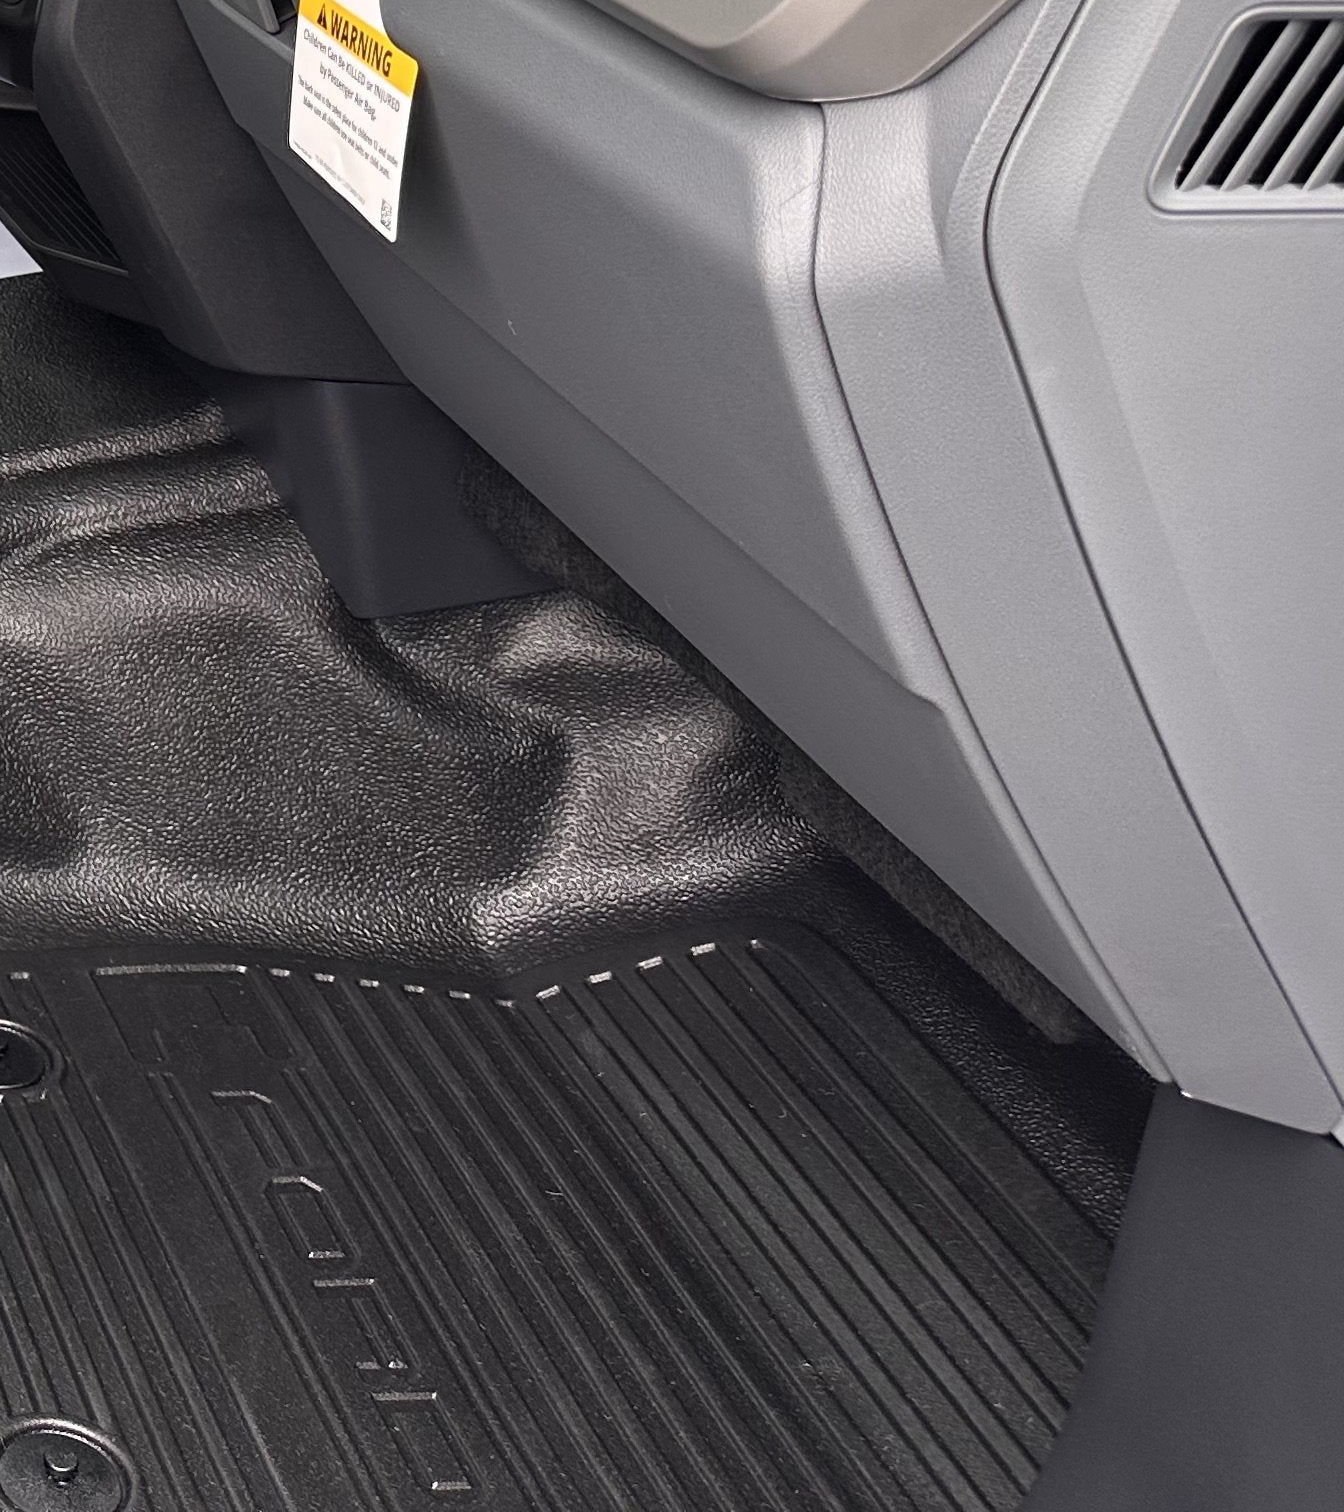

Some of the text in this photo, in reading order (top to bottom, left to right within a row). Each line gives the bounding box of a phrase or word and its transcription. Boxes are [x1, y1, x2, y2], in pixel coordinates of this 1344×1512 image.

[303, 28, 327, 54] Children
[345, 60, 366, 86] KILLED
[374, 83, 401, 112] INJURED
[331, 9, 393, 77] WARNING
